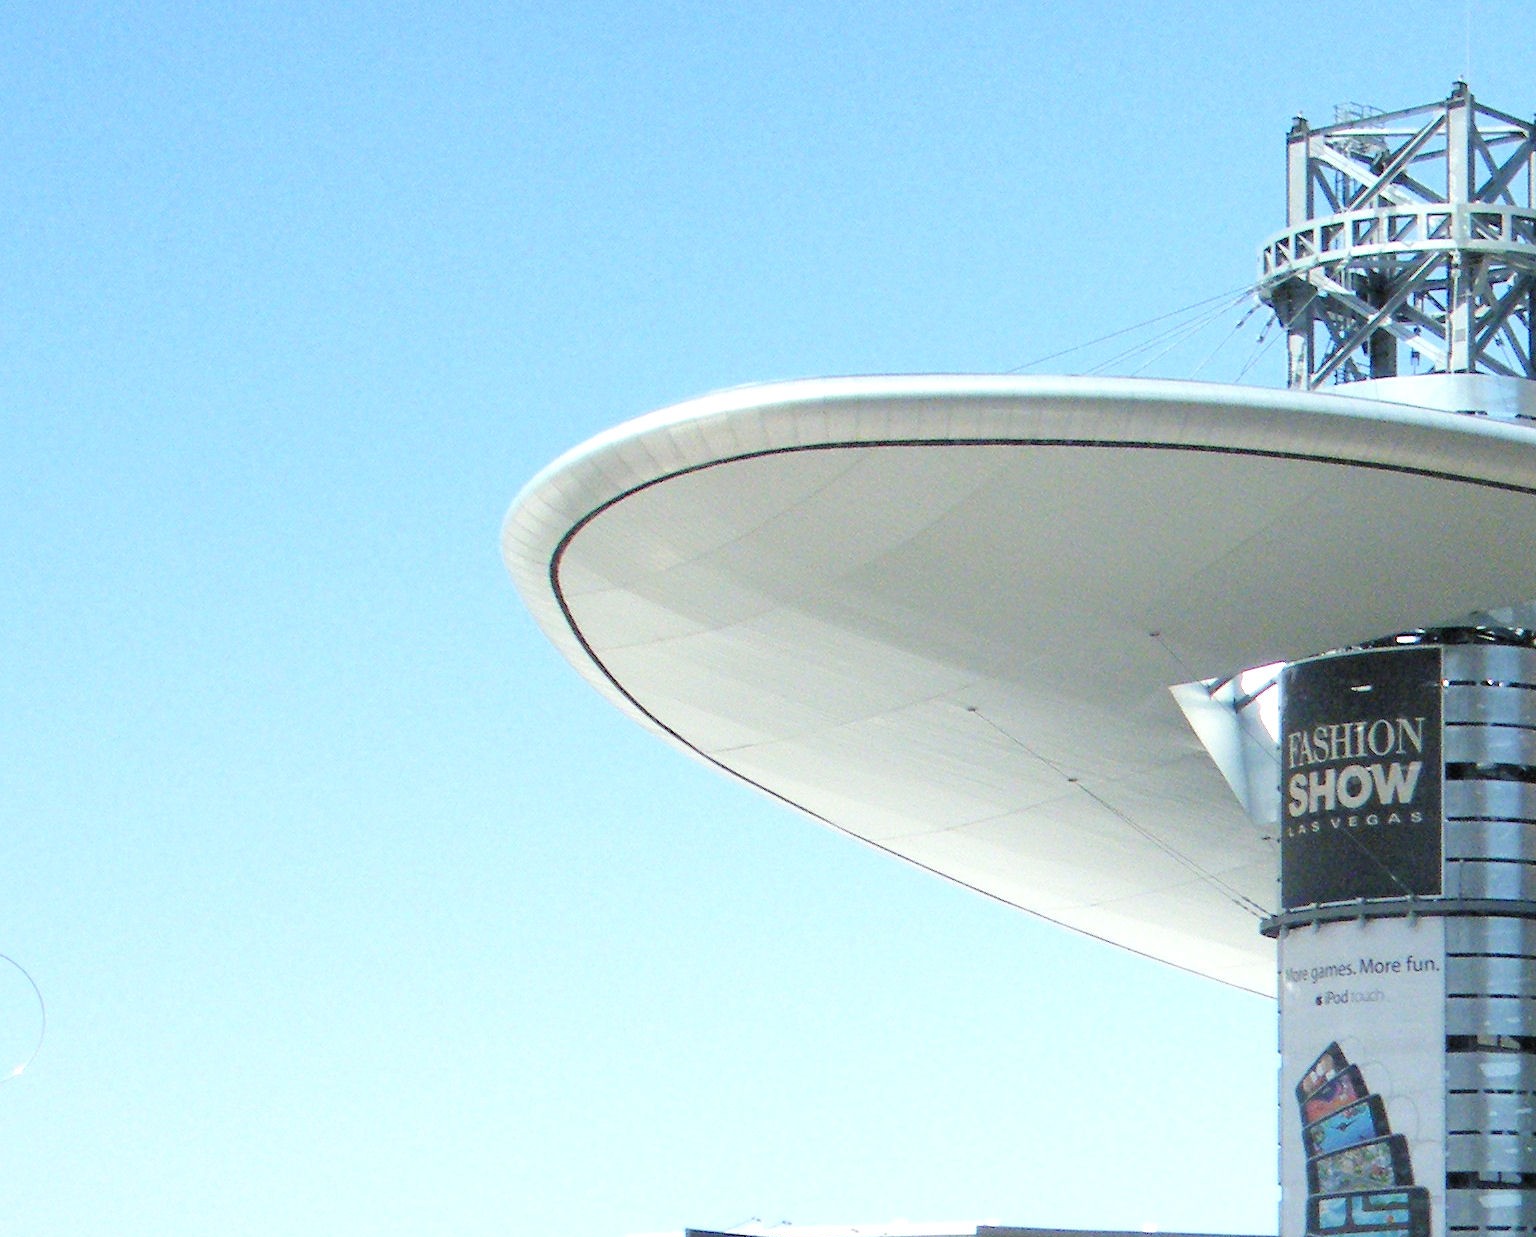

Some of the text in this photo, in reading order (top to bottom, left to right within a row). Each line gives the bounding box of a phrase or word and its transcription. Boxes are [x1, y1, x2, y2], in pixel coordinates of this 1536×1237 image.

[1288, 717, 1426, 769] FASHION
[1288, 760, 1423, 818] SHOW
[1288, 811, 1424, 838] LAS VEGAS
[1310, 963, 1357, 984] games.
[1359, 957, 1402, 975] More
[1406, 954, 1441, 973] fun.
